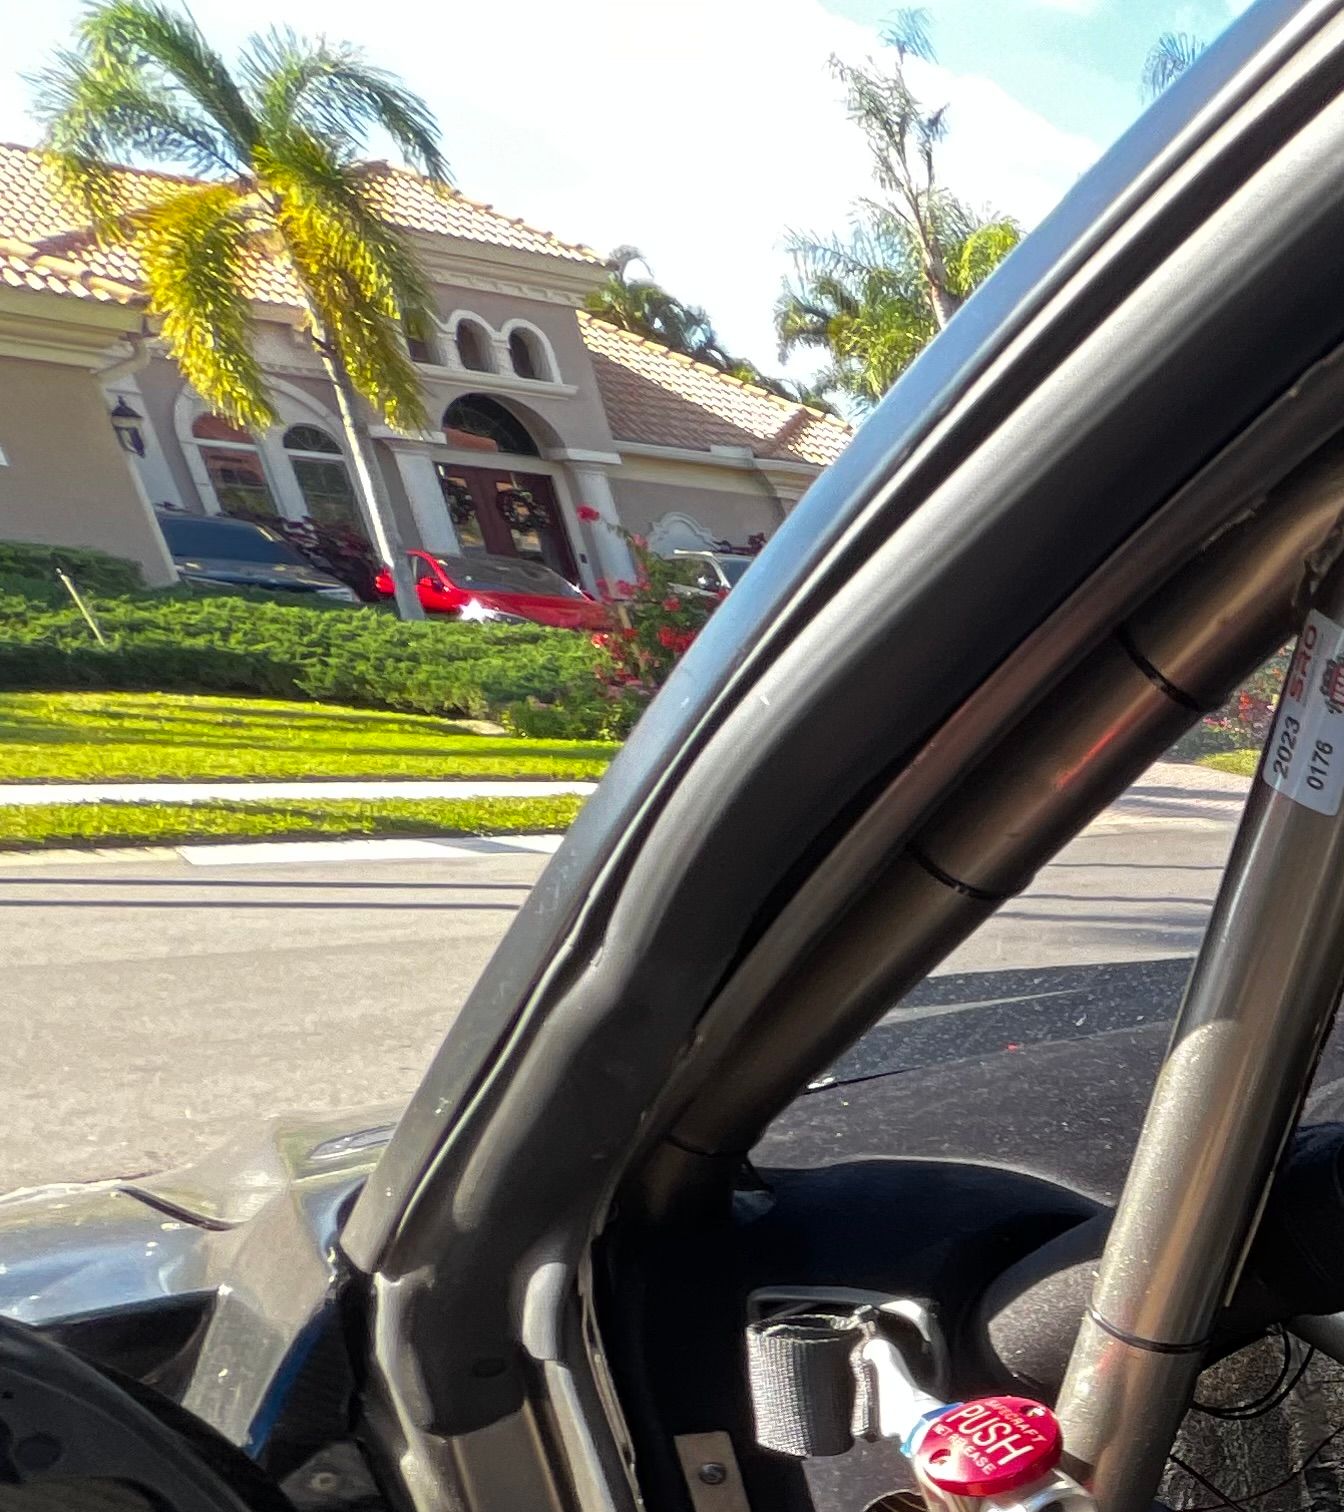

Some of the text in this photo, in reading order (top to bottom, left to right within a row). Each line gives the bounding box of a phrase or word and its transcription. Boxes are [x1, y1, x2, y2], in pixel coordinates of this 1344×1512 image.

[1290, 625, 1317, 702] SRO
[1273, 716, 1300, 779] 2023
[1307, 740, 1334, 790] 0176
[946, 1404, 1034, 1466] PUSH
[986, 1400, 1047, 1443] SAFECRAFT
[948, 1433, 997, 1475] RELEASE
